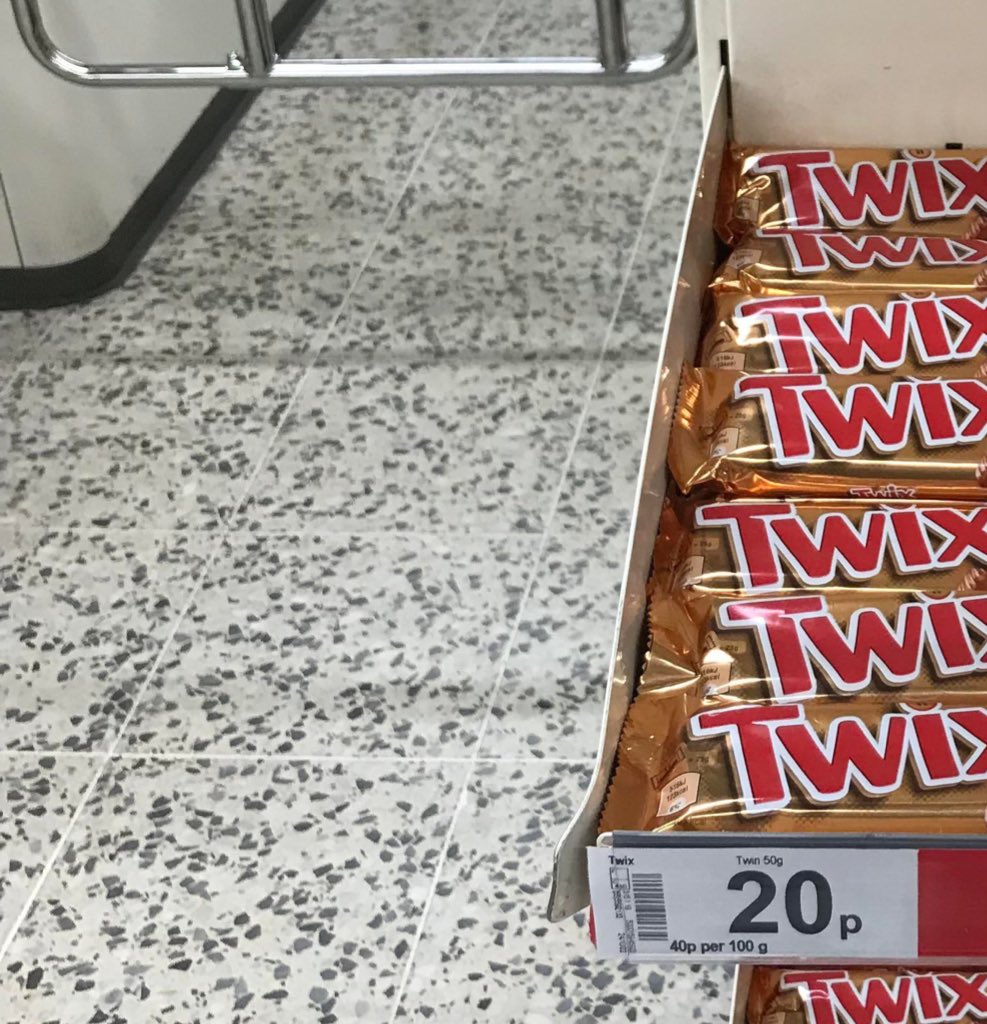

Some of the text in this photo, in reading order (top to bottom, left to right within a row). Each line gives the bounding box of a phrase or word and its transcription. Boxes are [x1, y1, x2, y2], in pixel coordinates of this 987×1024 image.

[608, 855, 635, 866] Twix
[736, 855, 783, 868] Twin 50g
[669, 940, 768, 955] 40p per 100 g
